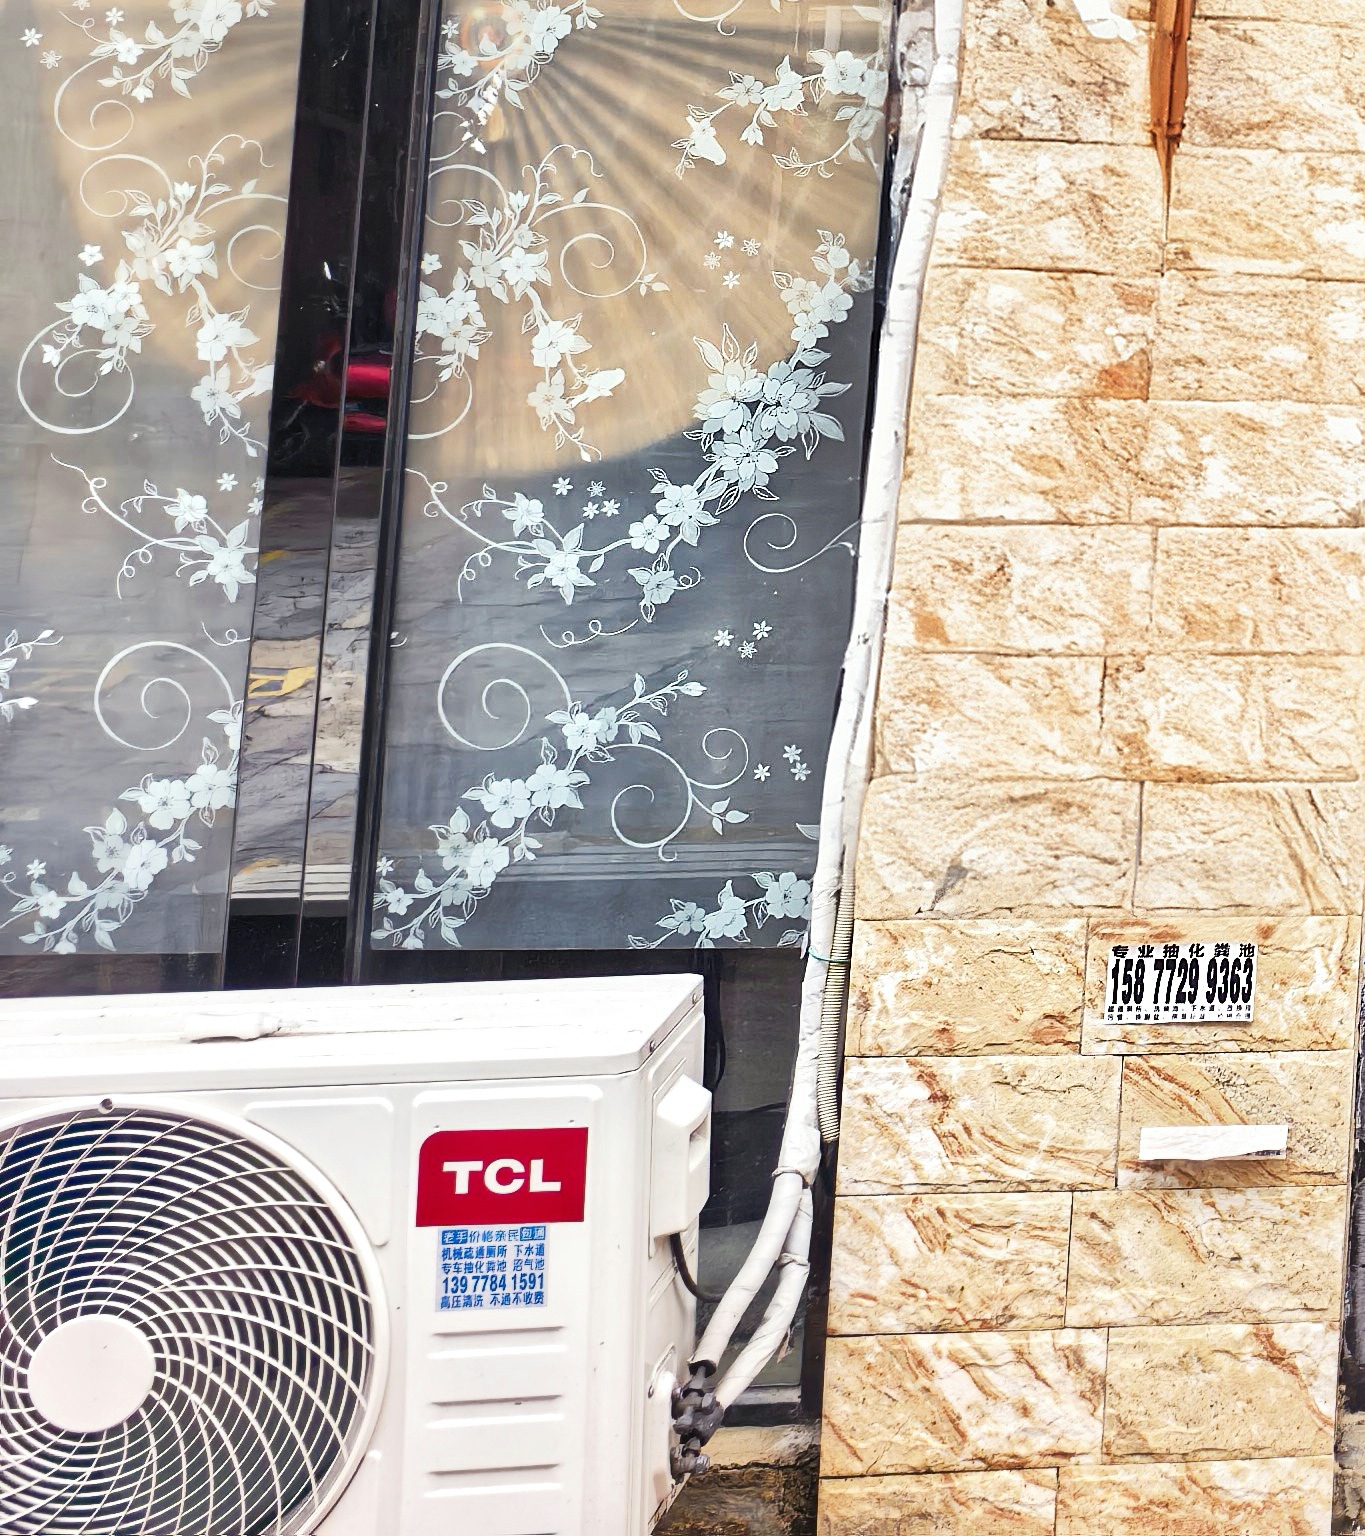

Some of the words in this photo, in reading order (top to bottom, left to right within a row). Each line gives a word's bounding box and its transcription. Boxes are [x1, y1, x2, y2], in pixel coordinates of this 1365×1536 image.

[1111, 943, 1256, 960] 专业抽化粪池
[1111, 958, 1146, 1005] 158
[1153, 958, 1200, 1005] 7729
[1205, 957, 1254, 1004] 9363
[442, 1158, 562, 1195] TCL
[513, 1242, 546, 1259] 下水道
[512, 1257, 545, 1272] 沼气池
[442, 1275, 468, 1294] 139
[471, 1273, 507, 1293] 7784
[511, 1272, 545, 1291] 1591
[440, 1295, 484, 1310] 高压清洗
[490, 1290, 545, 1306] 不通不收费
